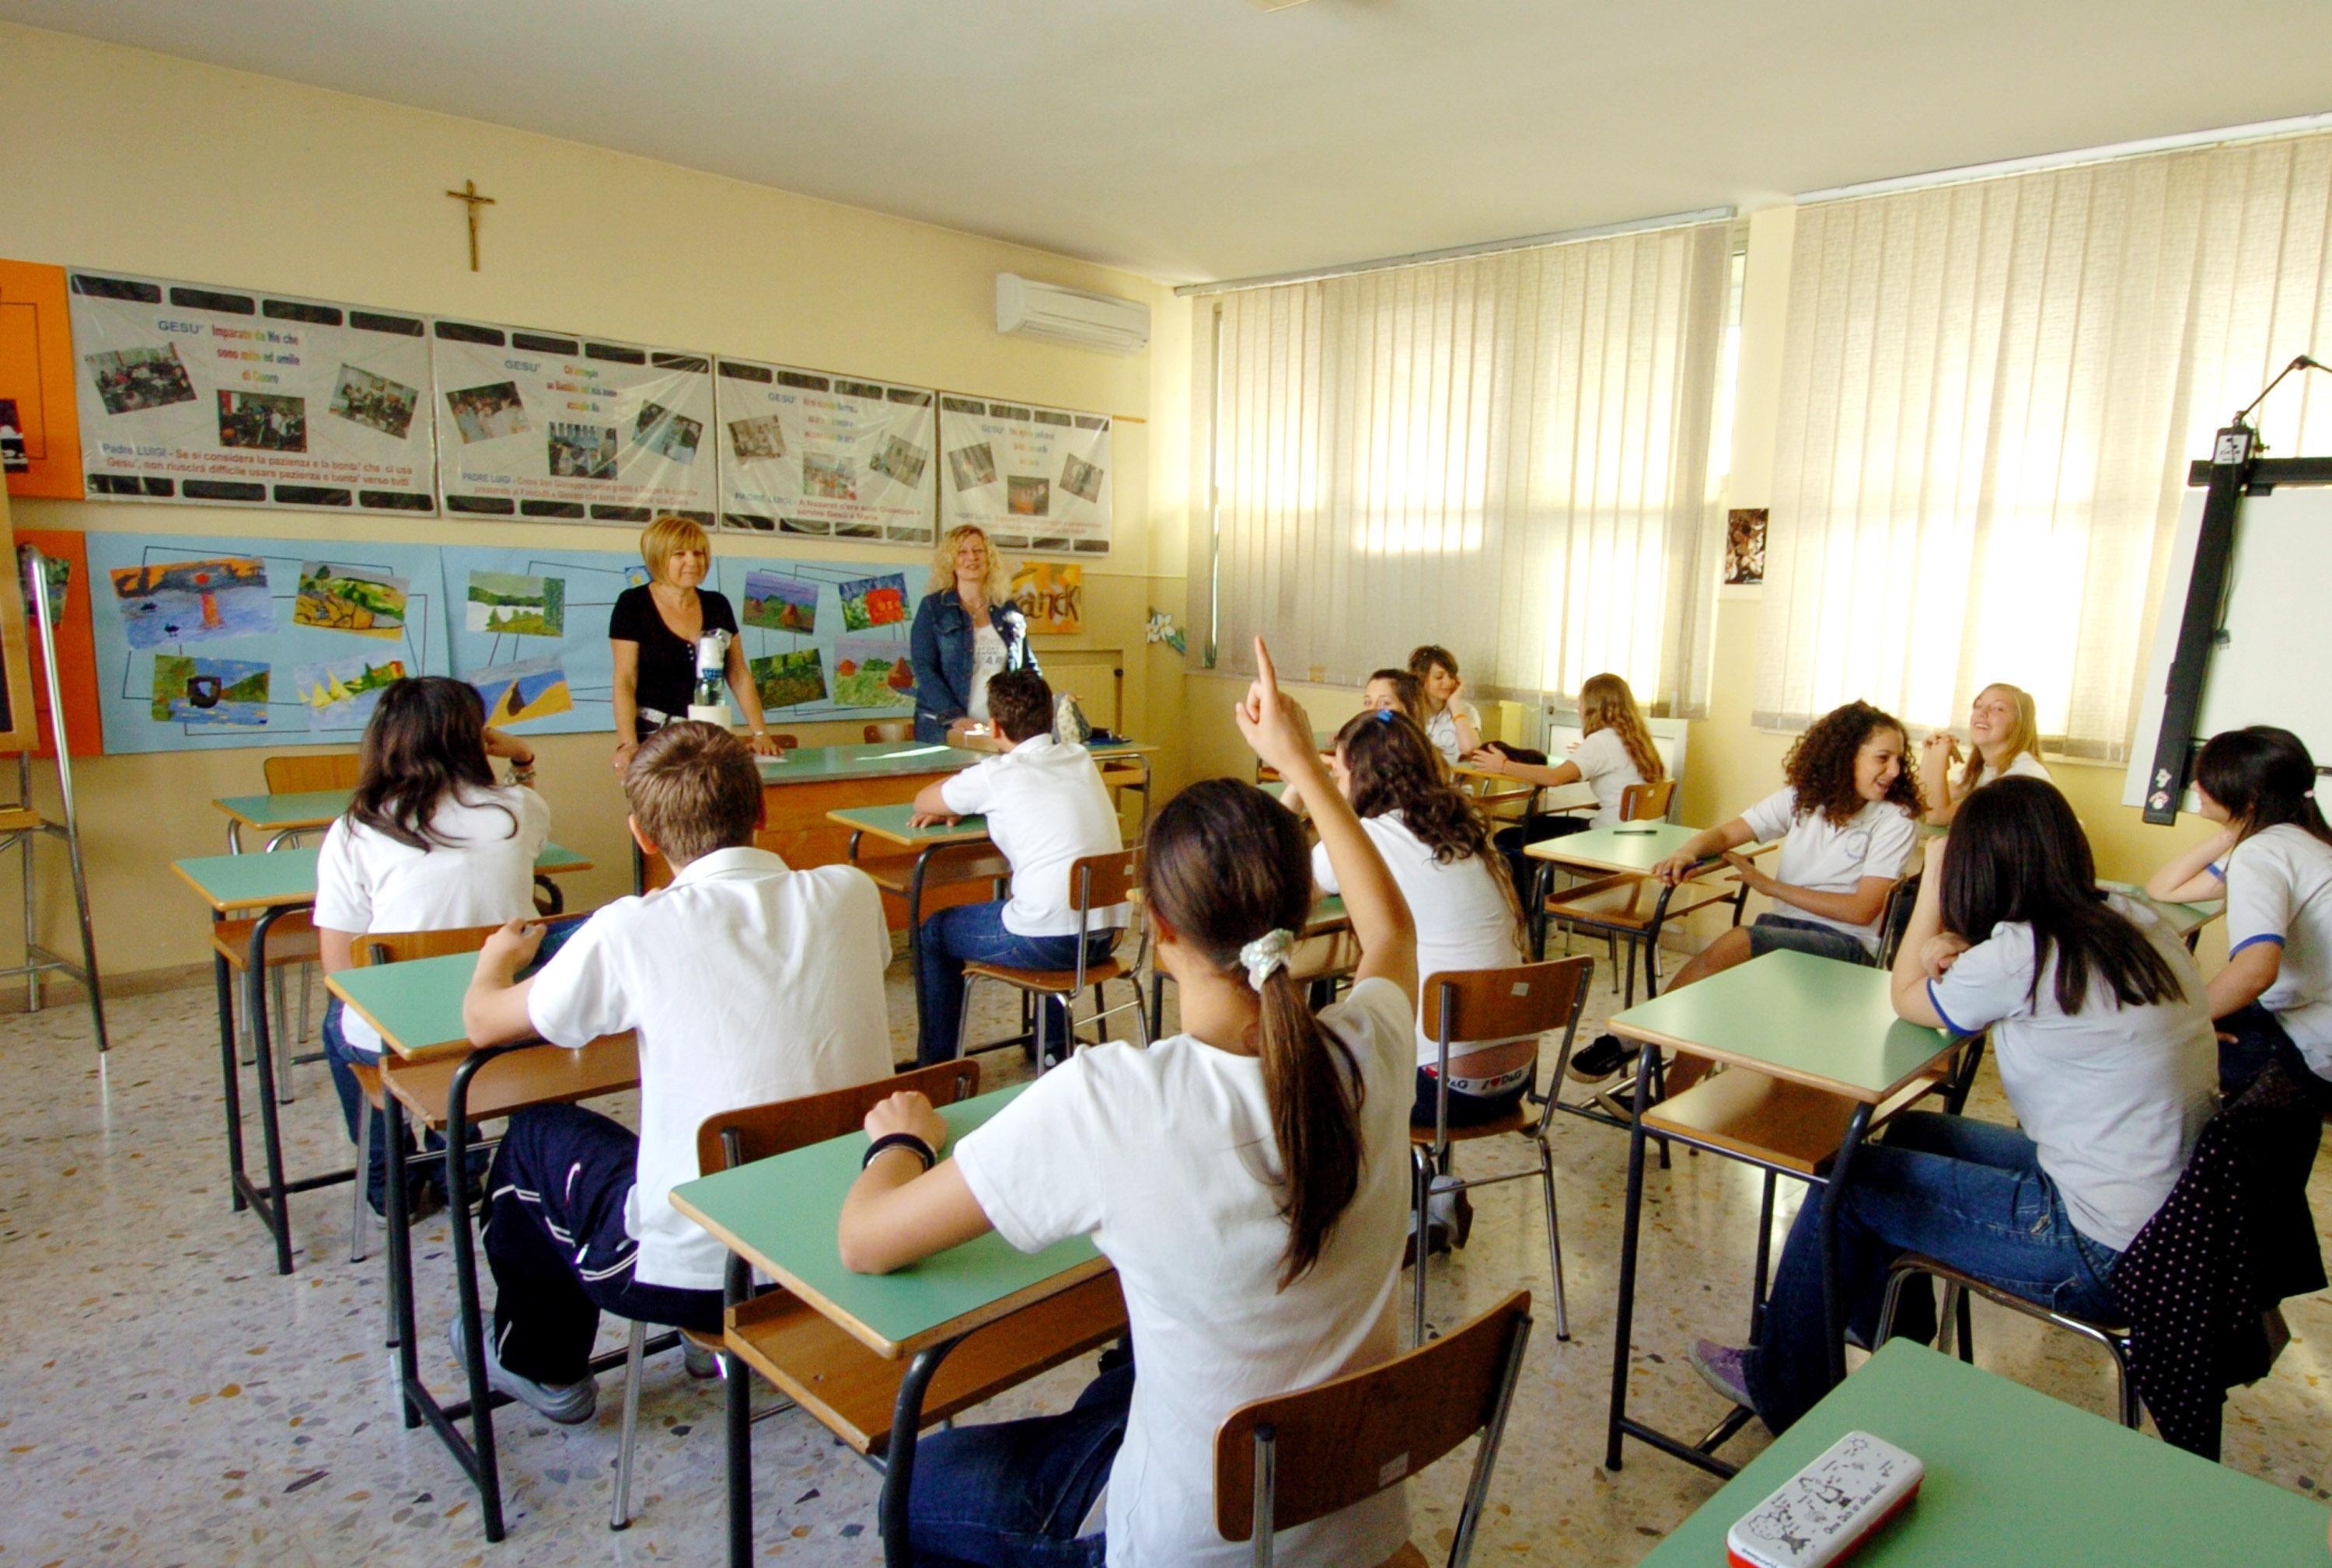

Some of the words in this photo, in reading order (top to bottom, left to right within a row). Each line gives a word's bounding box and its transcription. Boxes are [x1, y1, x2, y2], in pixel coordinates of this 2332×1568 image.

[158, 320, 203, 334] GESU'
[504, 359, 540, 372] GESU'
[103, 443, 134, 454] Padre
[137, 445, 167, 457] LUIGI
[176, 449, 189, 459] Se
[192, 451, 201, 460] si
[204, 451, 254, 464] considera
[257, 455, 266, 464] la
[268, 456, 311, 468] pazienza
[363, 463, 381, 473] che
[144, 460, 164, 470] non
[208, 463, 246, 476] difficile
[248, 468, 277, 478] usare
[279, 469, 321, 481] pazienza
[1447, 1076, 1468, 1089] &G
